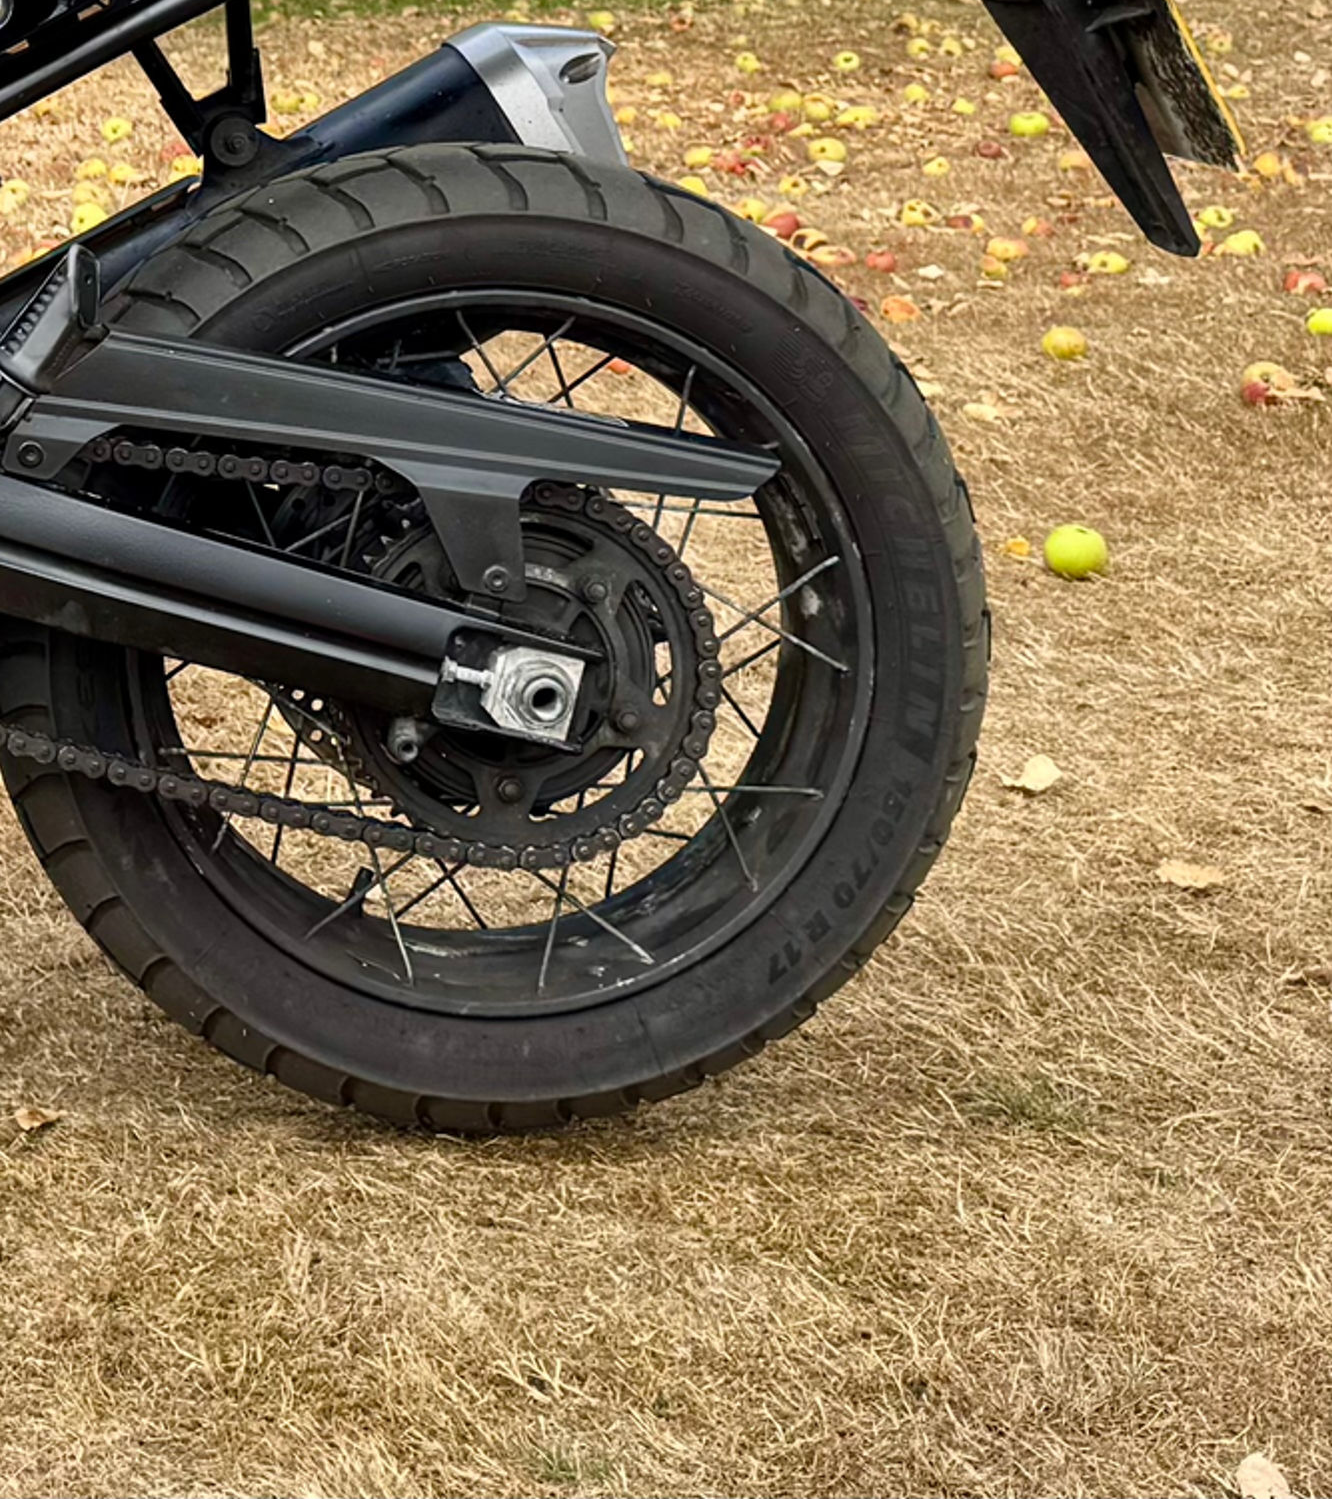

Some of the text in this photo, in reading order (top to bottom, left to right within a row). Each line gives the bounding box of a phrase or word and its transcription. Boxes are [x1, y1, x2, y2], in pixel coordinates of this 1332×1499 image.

[836, 409, 942, 742] MICHELIN
[834, 777, 913, 909] 150/70
[768, 941, 803, 986] 17
